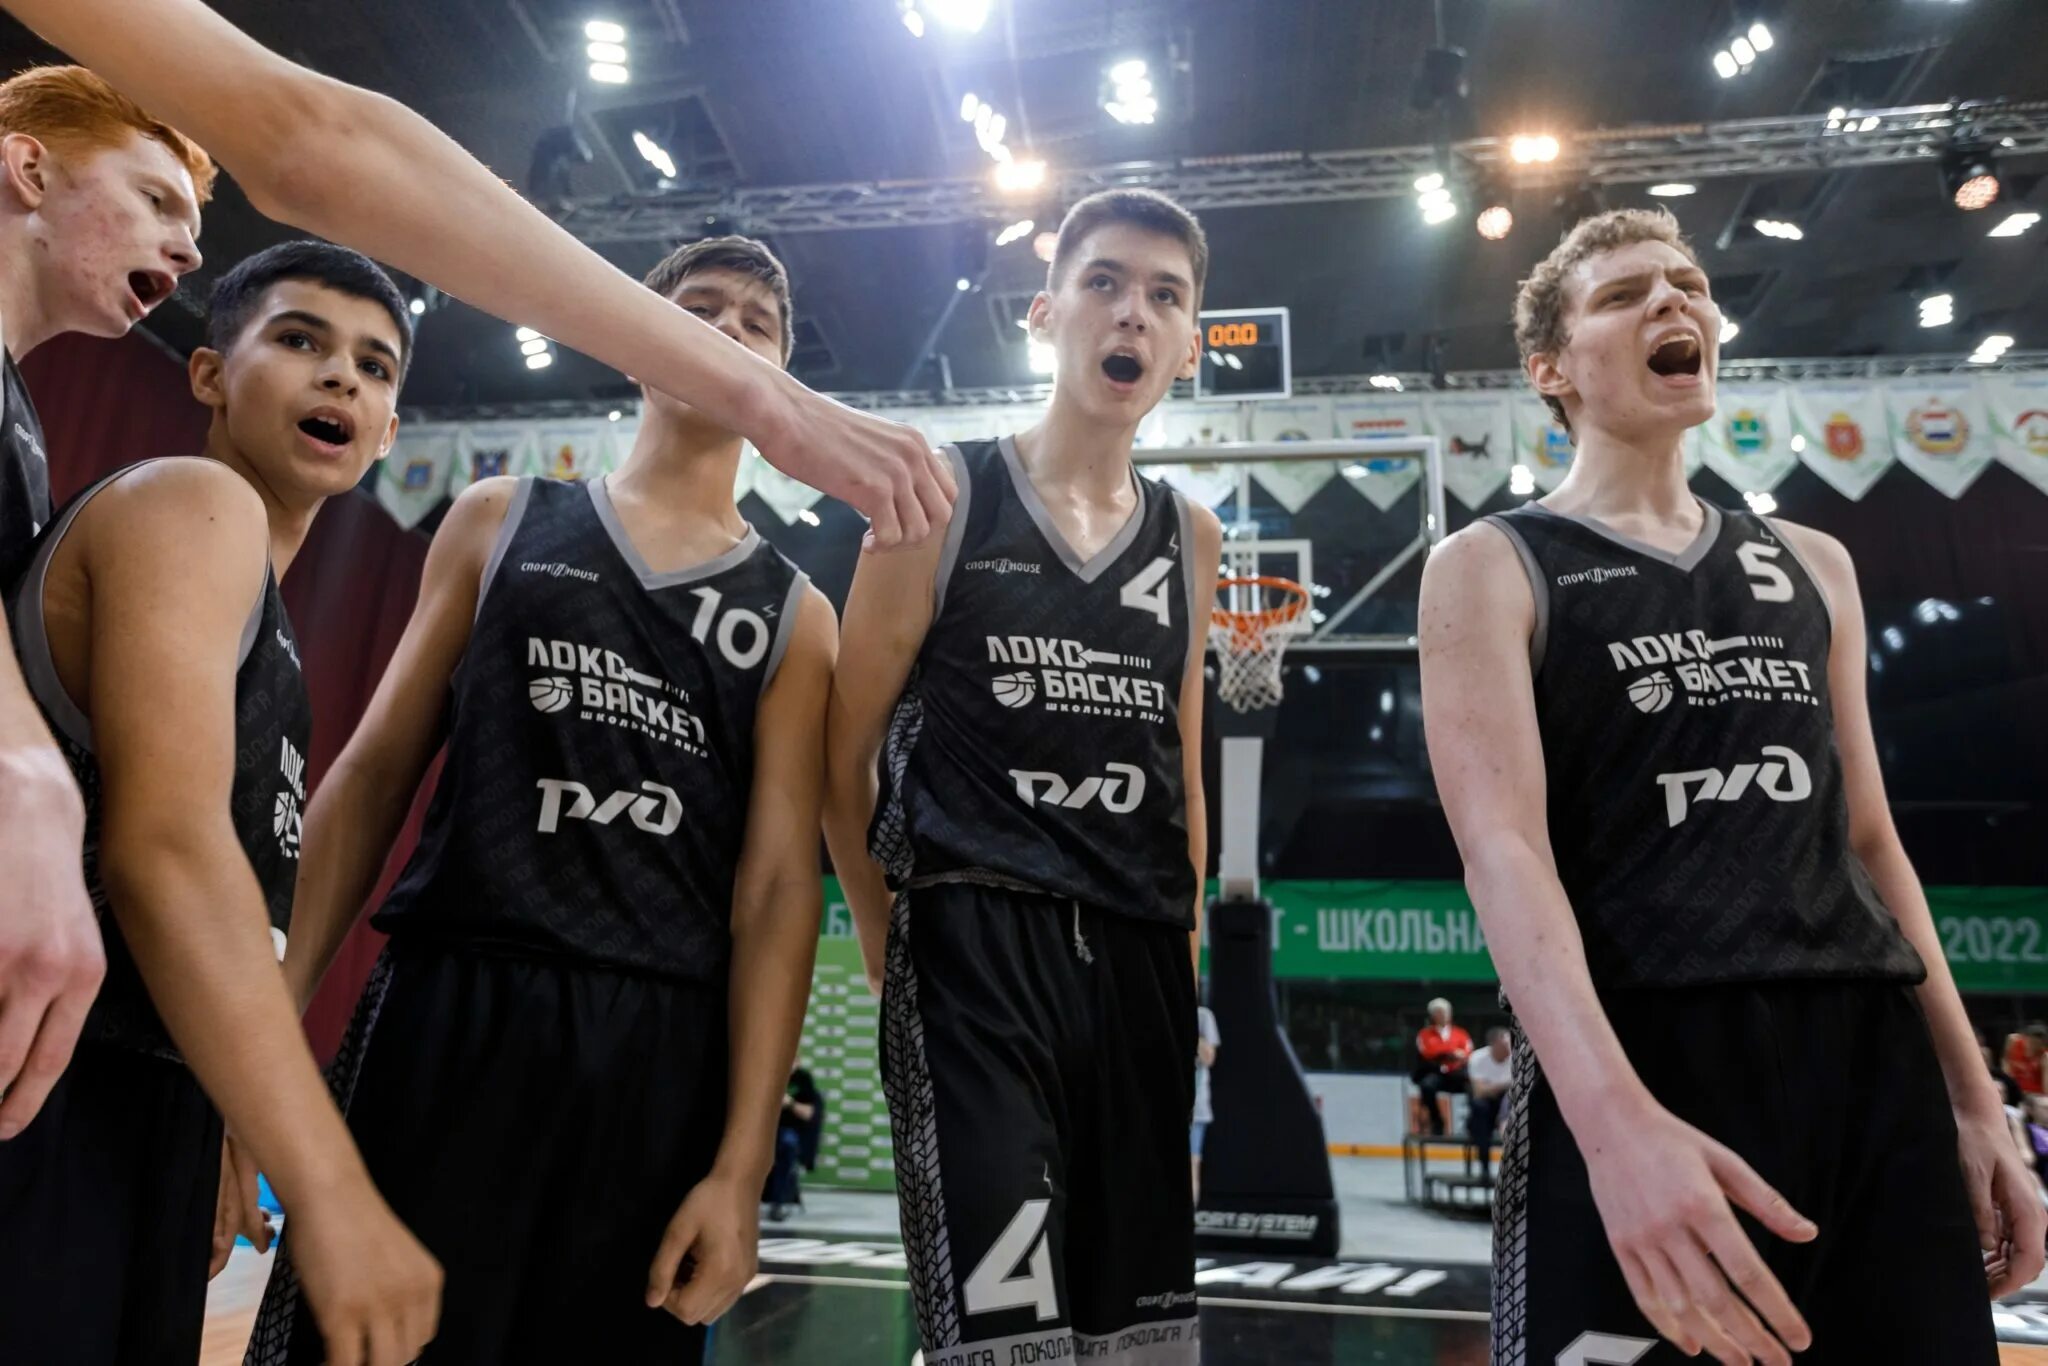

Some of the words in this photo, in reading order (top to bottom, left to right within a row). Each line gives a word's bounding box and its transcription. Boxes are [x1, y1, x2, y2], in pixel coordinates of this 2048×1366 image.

[1120, 556, 1175, 628] 4
[1735, 540, 1795, 603] 5
[689, 586, 769, 670] 10
[1041, 669, 1165, 711] БАСКЕТ
[1676, 657, 1812, 694] БАСКЕТ
[580, 676, 706, 744] БАСКЕТ
[1317, 907, 1489, 953] ШКОЛЬНА
[963, 1198, 1060, 1322] 4
